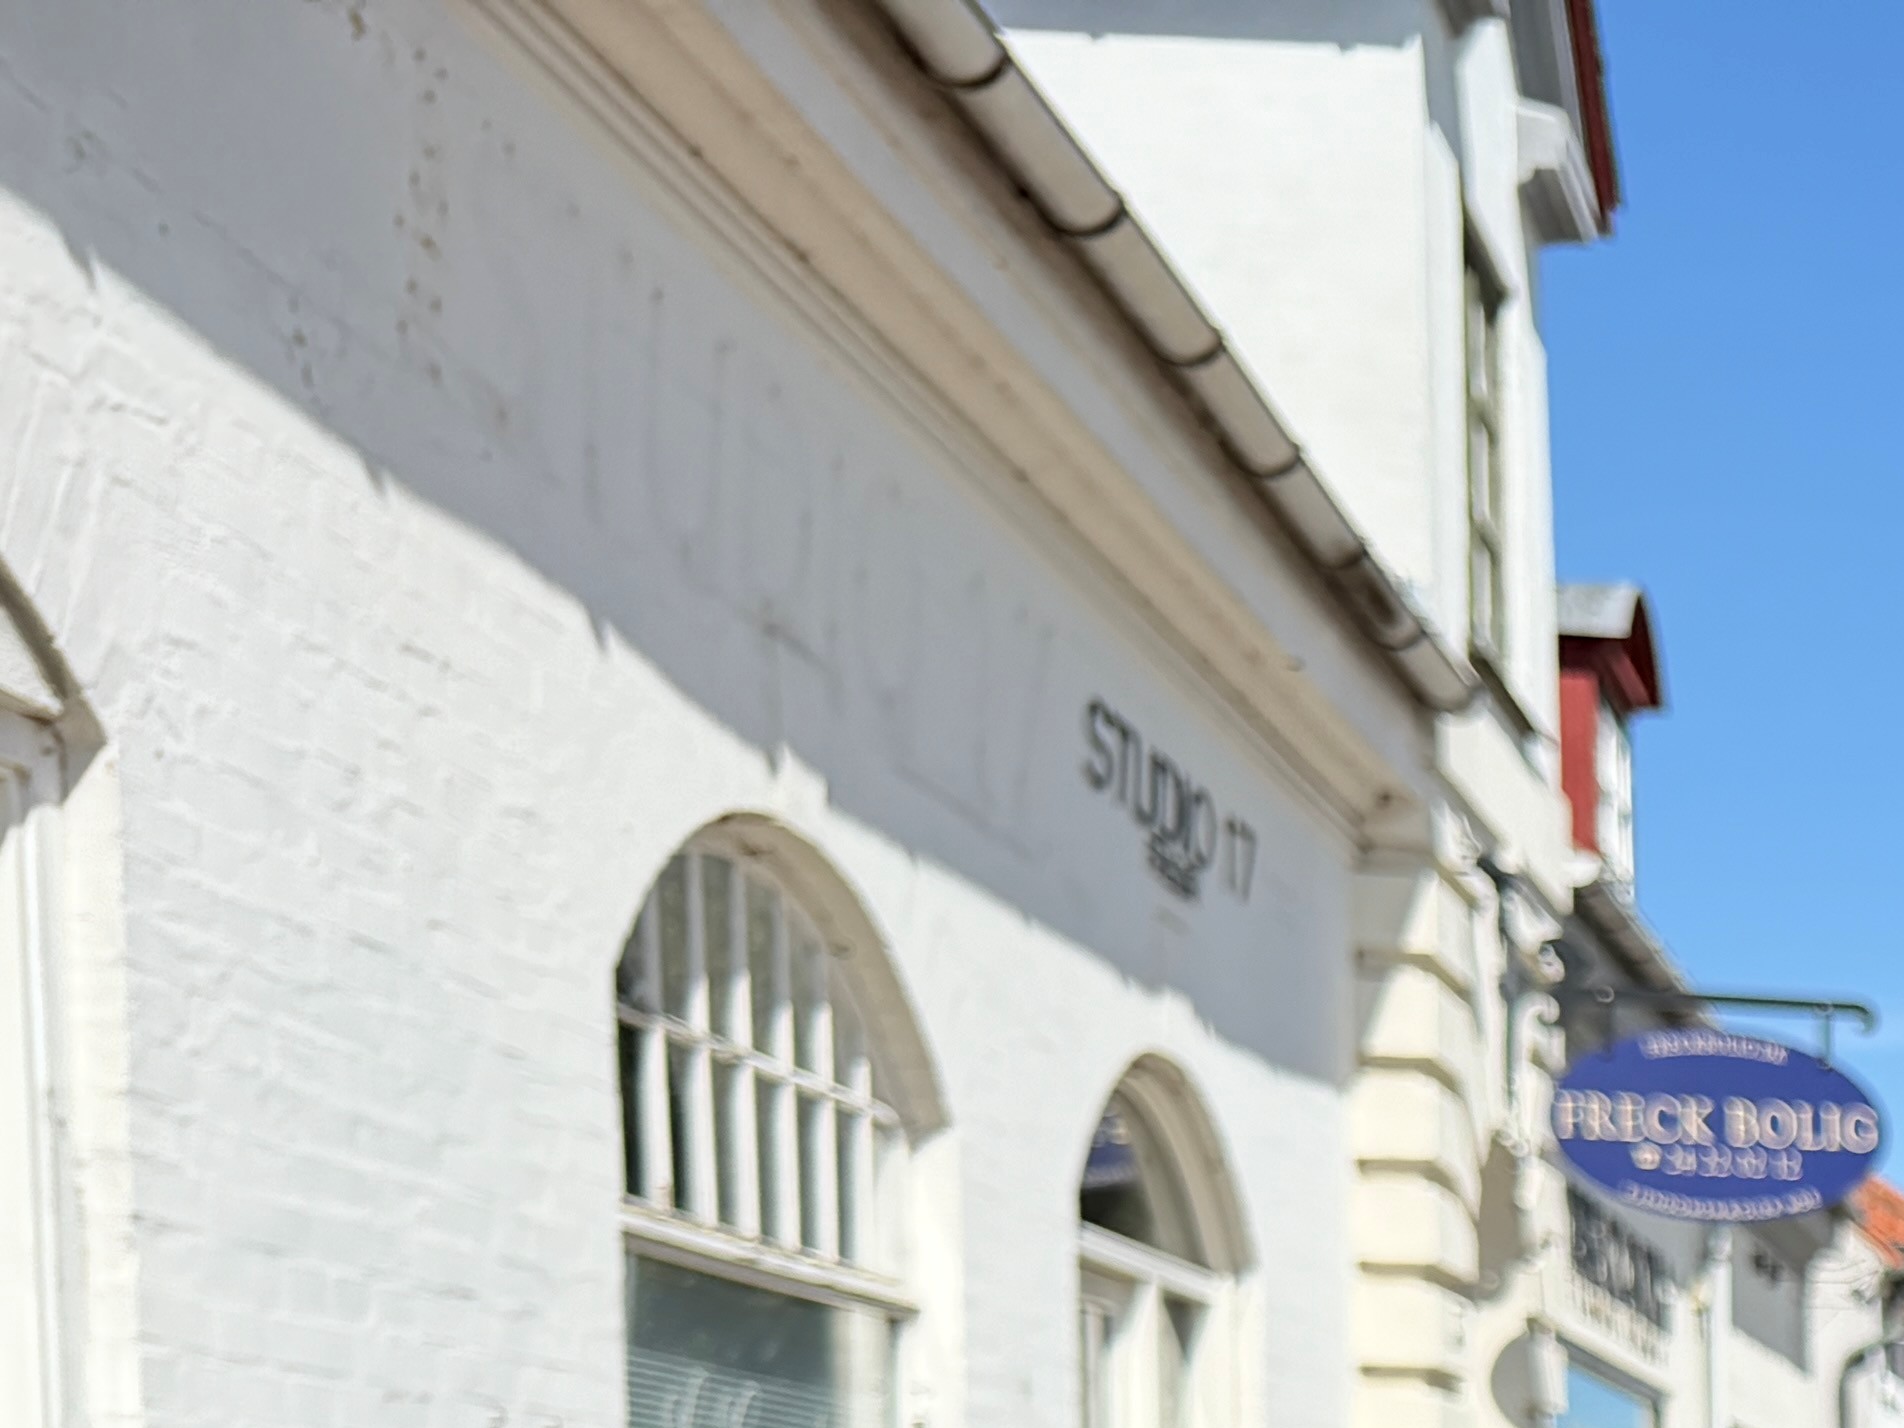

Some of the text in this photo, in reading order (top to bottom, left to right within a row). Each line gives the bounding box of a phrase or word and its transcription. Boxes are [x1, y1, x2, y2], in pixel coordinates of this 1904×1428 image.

[1083, 699, 1217, 868] STUDIO
[1224, 815, 1257, 902] 17
[1552, 1090, 1879, 1154] FRECK BOLIG
